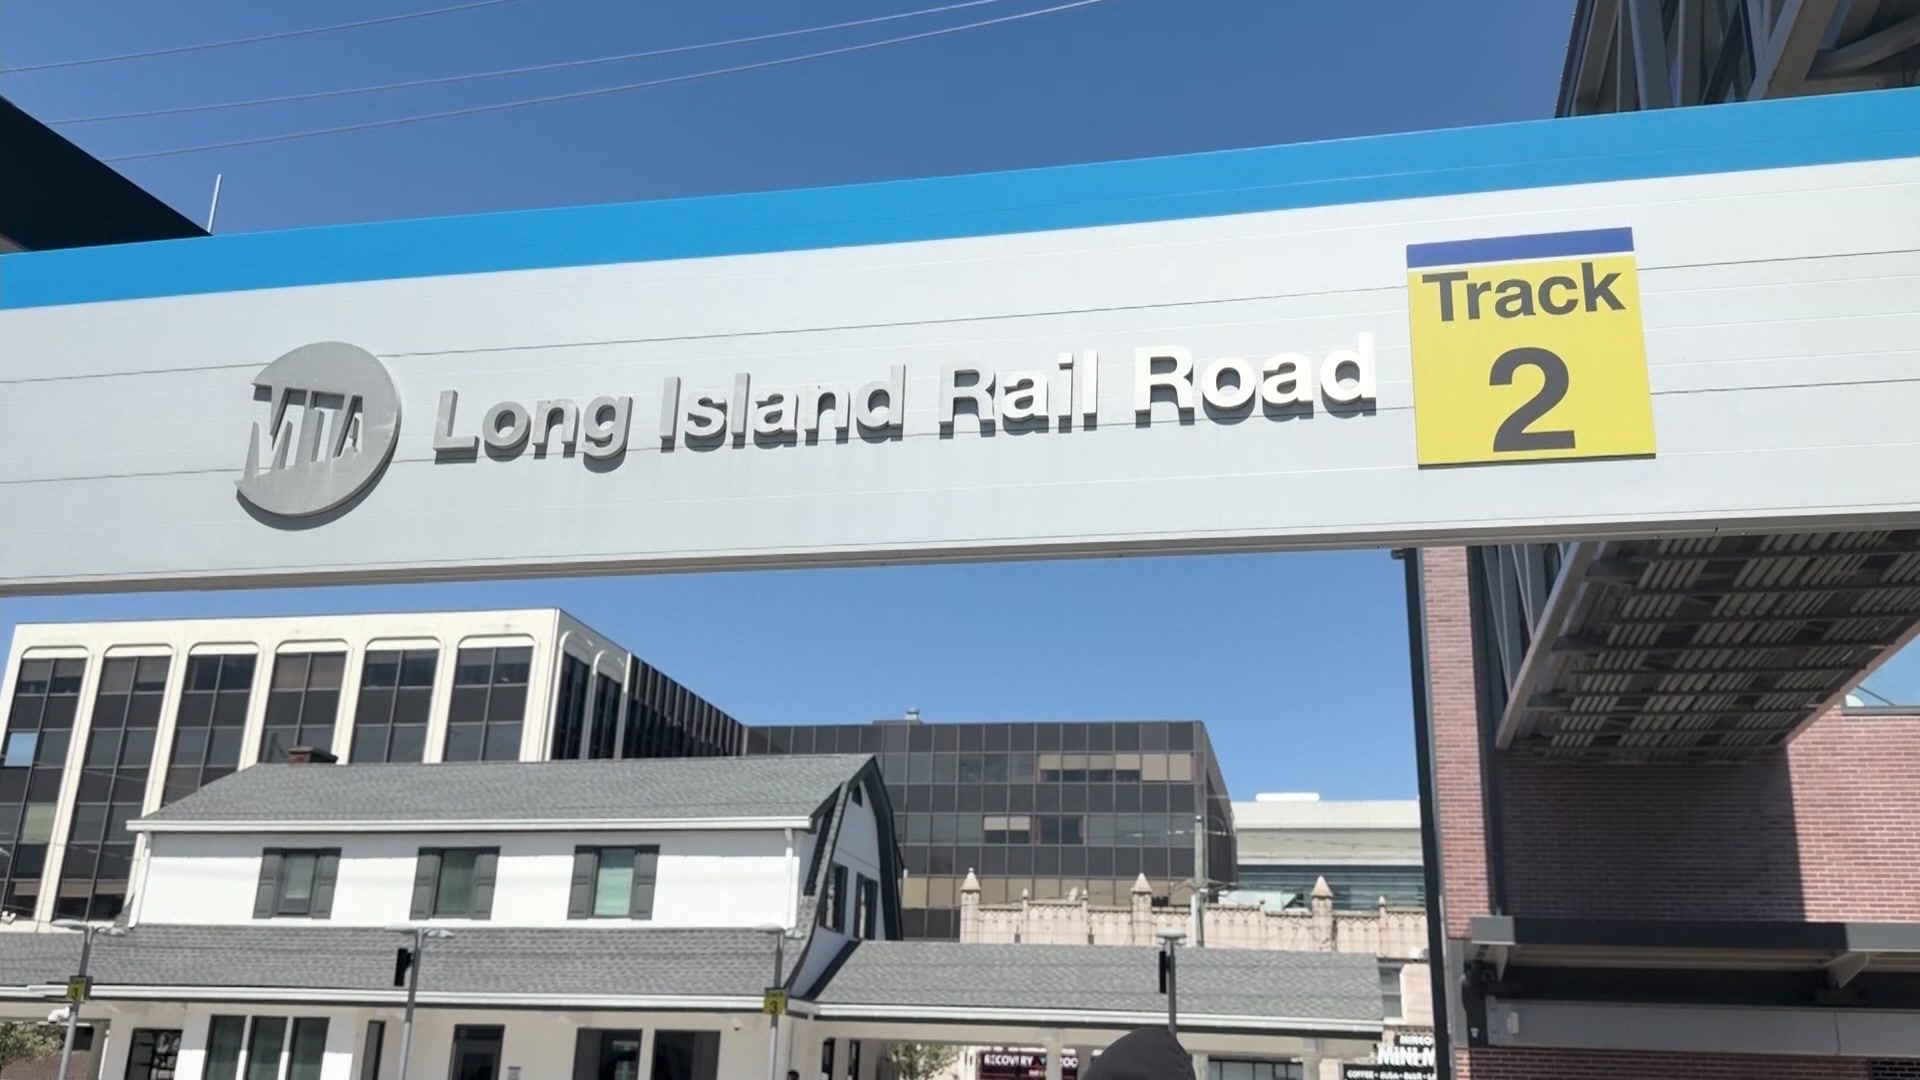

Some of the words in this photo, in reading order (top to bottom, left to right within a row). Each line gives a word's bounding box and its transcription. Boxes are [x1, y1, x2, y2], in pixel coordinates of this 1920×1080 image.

[1422, 261, 1627, 322] Track
[433, 390, 633, 460] Long
[660, 363, 906, 439] Island
[938, 350, 1098, 429] Rail
[1134, 331, 1376, 414] Road
[1488, 346, 1576, 453] 2
[769, 1000, 778, 1014] 3
